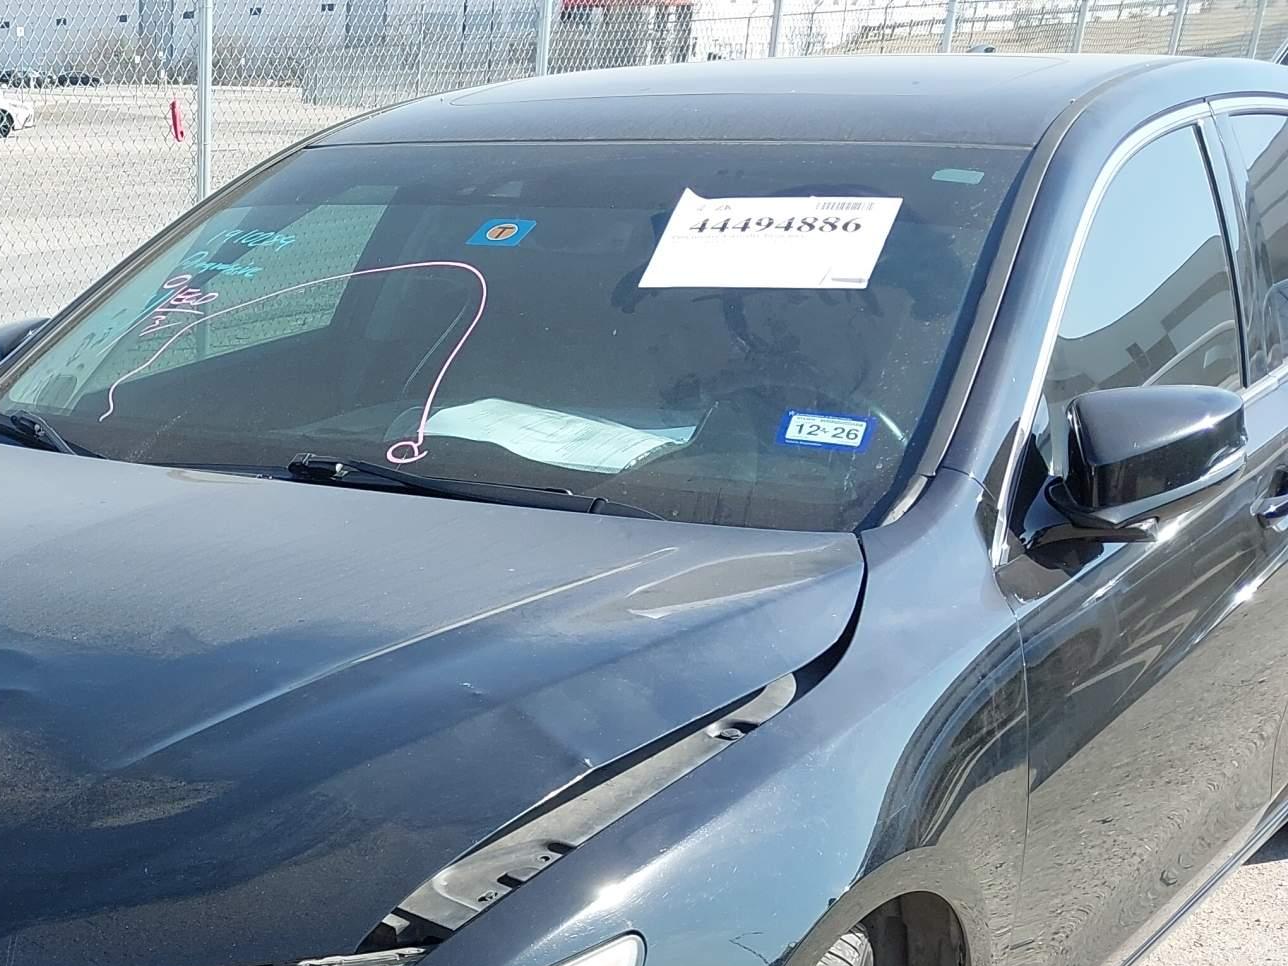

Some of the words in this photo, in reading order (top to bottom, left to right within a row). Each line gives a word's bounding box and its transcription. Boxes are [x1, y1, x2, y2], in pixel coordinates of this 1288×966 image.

[689, 216, 862, 233] 44494886
[796, 423, 821, 437] 12
[831, 426, 860, 441] 26
